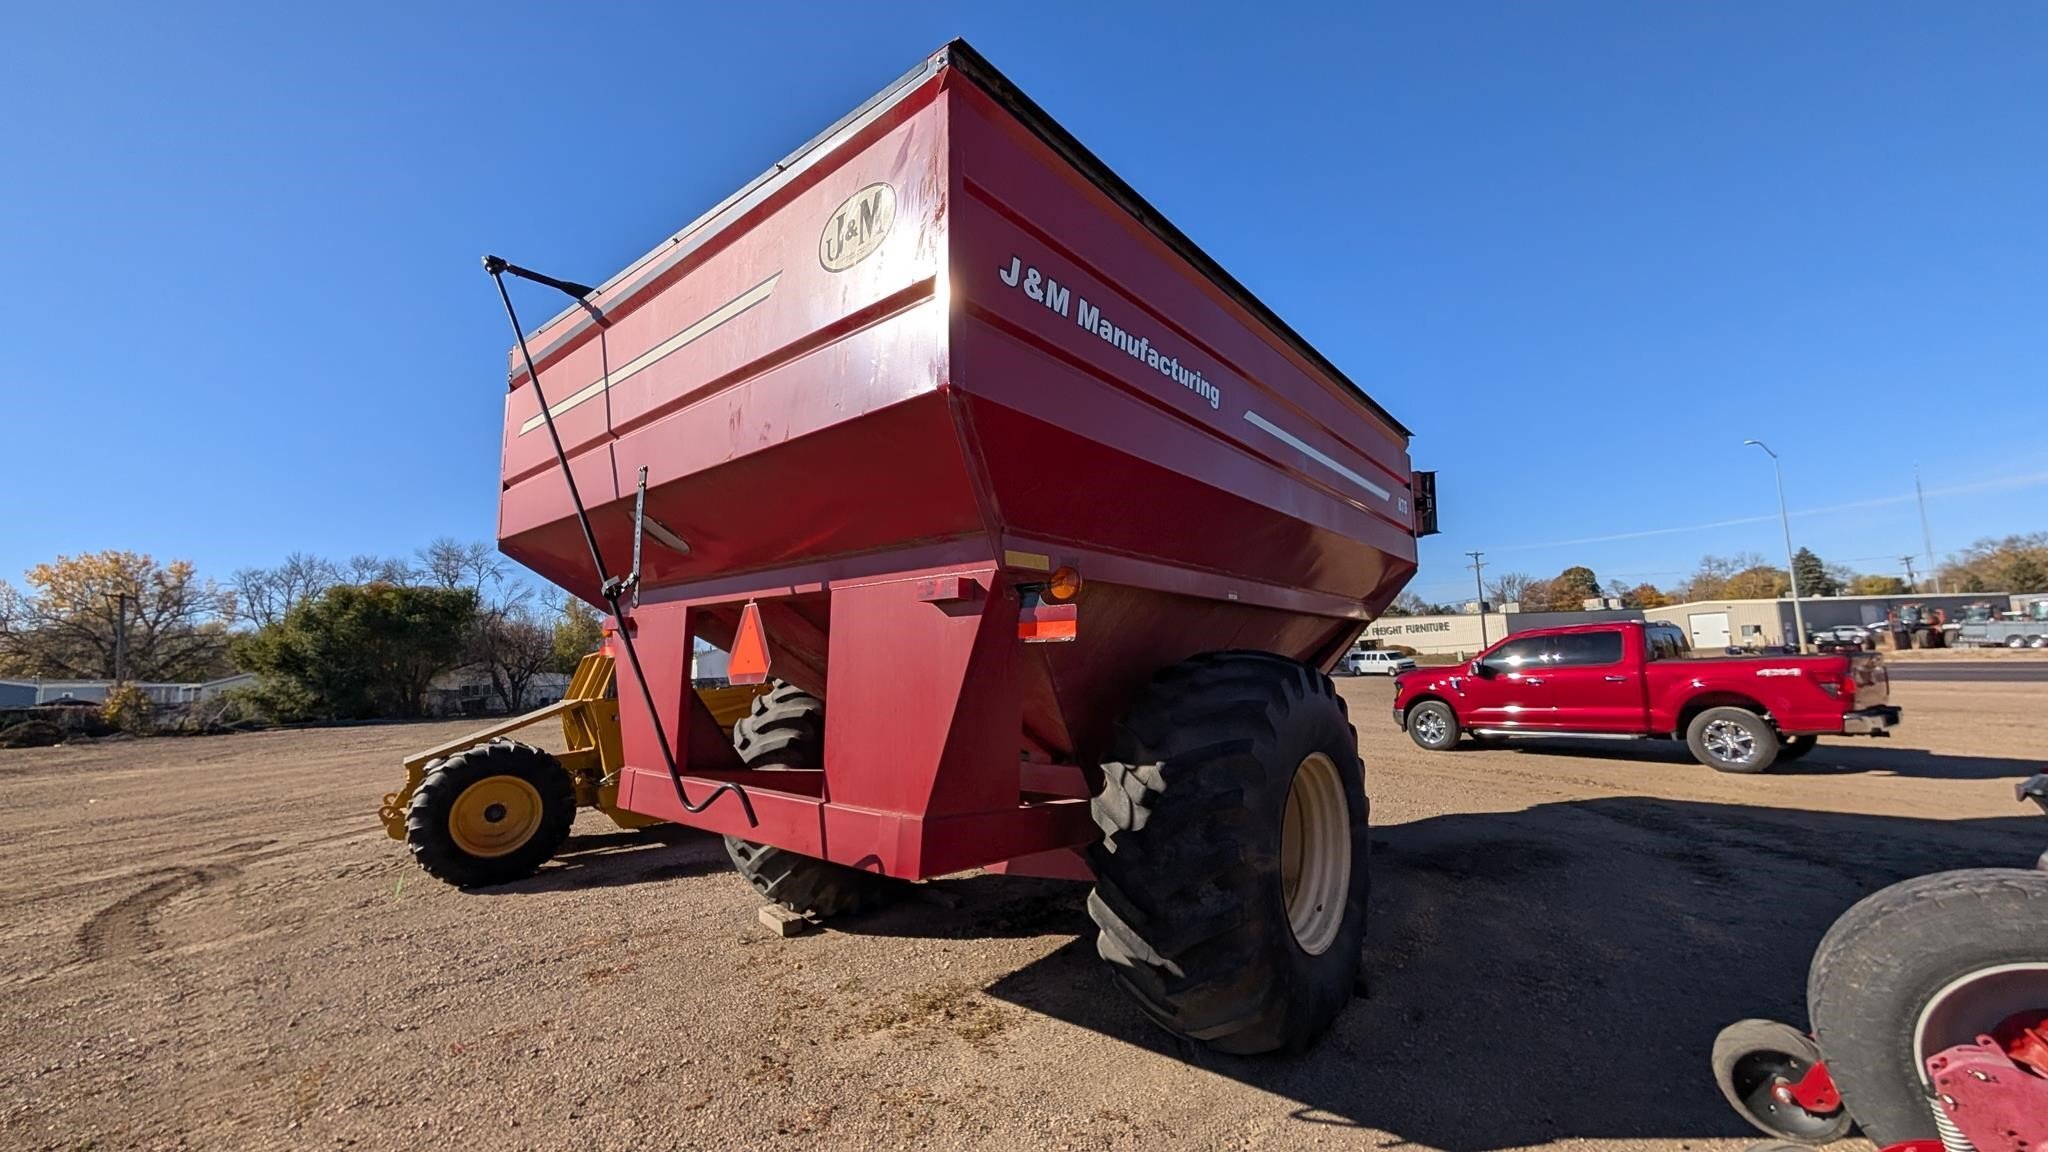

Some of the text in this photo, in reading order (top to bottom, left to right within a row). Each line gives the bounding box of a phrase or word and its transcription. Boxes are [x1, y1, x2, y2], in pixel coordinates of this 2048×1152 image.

[826, 189, 885, 262] J&M
[1077, 298, 1220, 410] Manufacturing
[1372, 625, 1402, 637] FREIGHT
[1406, 621, 1450, 635] FURNITURE
